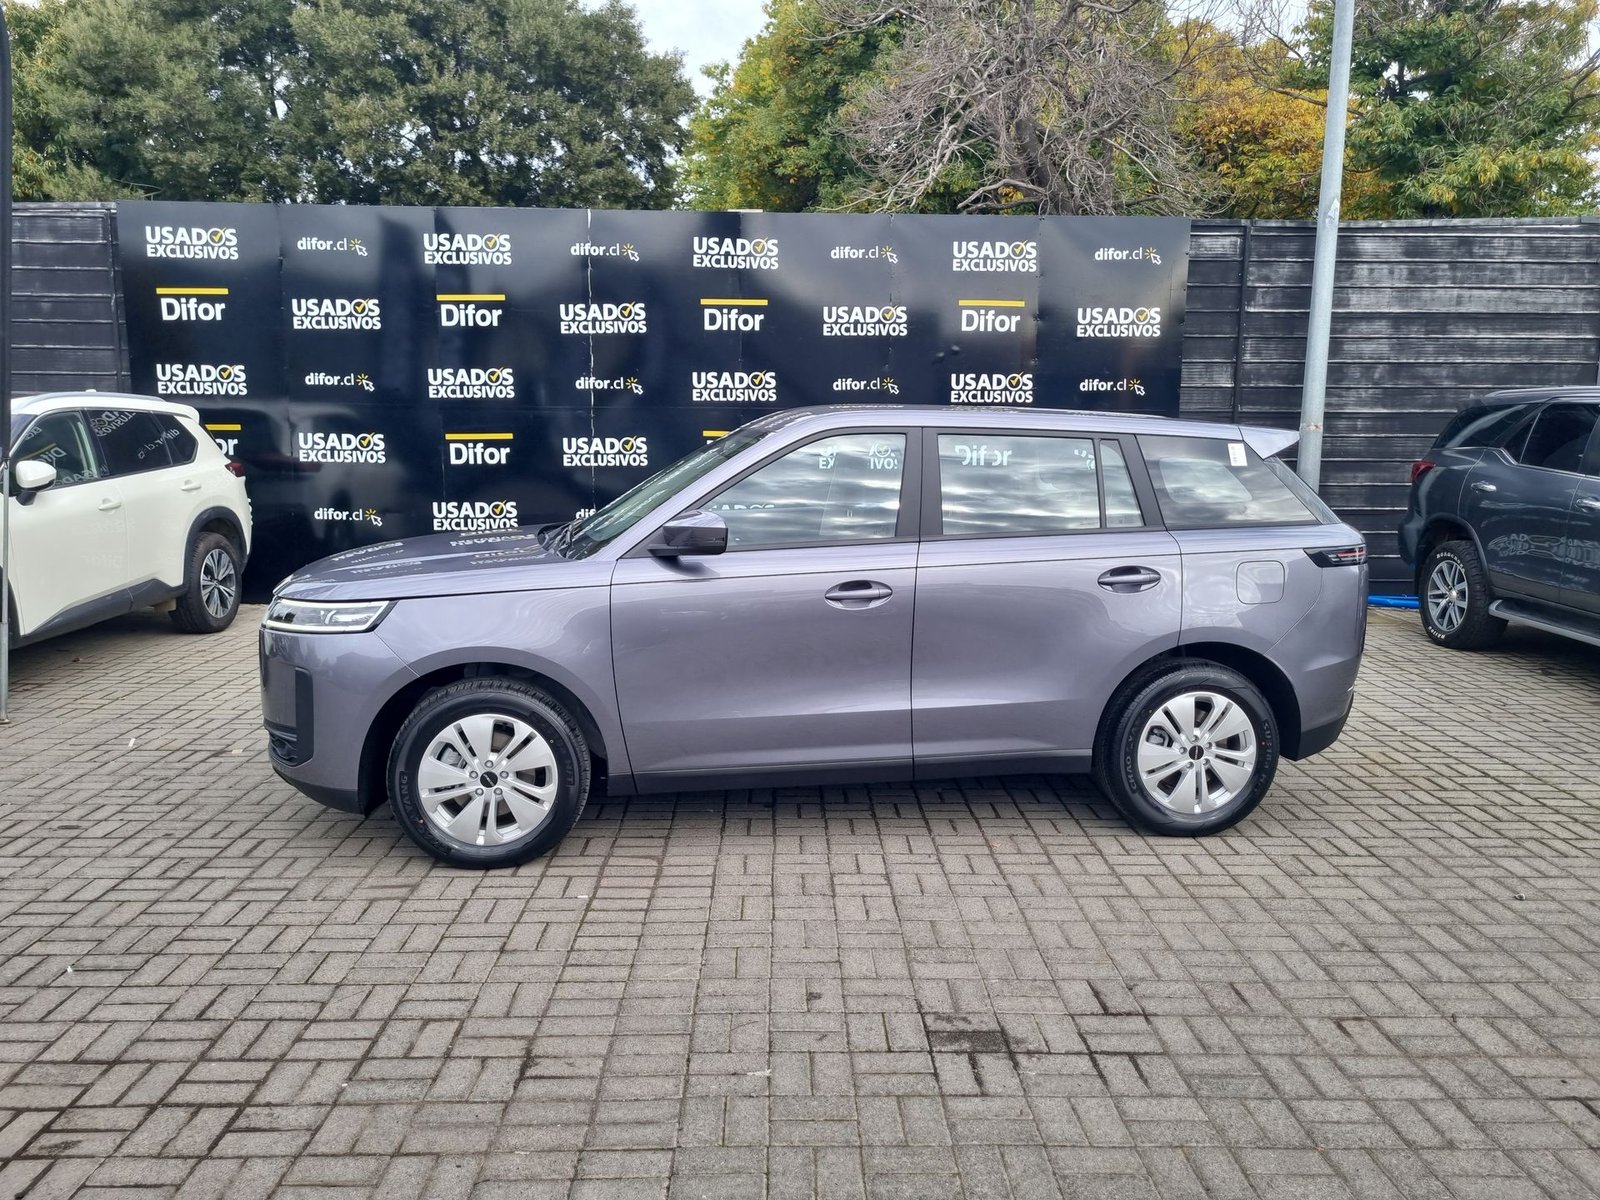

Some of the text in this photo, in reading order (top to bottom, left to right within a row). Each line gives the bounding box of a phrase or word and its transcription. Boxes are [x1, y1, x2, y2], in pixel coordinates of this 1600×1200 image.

[145, 226, 238, 246] USADOS
[423, 232, 512, 251] USADOS
[297, 237, 347, 251] difor.cl
[570, 243, 620, 257] difor.cl
[693, 236, 779, 257] USADOS
[952, 240, 1037, 259] USADOS
[146, 244, 239, 260] EXCLUSIVOS
[424, 251, 512, 266] EXCLUSIVOS
[830, 246, 879, 259] difor.cl
[1094, 247, 1143, 261] difor.cl
[693, 254, 779, 270] EXCLUSIVOS
[952, 258, 1037, 272] EXCLUSIVOS
[160, 297, 226, 321] Difor
[292, 298, 381, 317] USADOS
[440, 303, 503, 327] Difor
[559, 302, 646, 321] USADOS
[822, 305, 907, 324] USADOS
[293, 316, 382, 330] EXCLUSIVOS
[703, 308, 765, 332] Difor
[960, 309, 1021, 333] Difor
[1077, 306, 1161, 325] USADOS
[560, 320, 647, 335] EXCLUSIVOS
[823, 323, 908, 337] EXCLUSIVOS
[1076, 324, 1161, 338] EXCLUSIVOS
[156, 364, 246, 382] USADOS
[305, 372, 355, 386] difor.cl
[427, 367, 514, 386] USADOS
[692, 370, 776, 389] USADOS
[157, 381, 247, 396] EXCLUSIVOS
[575, 376, 624, 390] difor.cl
[832, 377, 881, 391] difor.cl
[951, 372, 1033, 391] USADOS
[1079, 378, 1127, 392] difor.cl
[428, 385, 515, 399] EXCLUSIVOS
[692, 388, 777, 402] EXCLUSIVOS
[950, 390, 1033, 404] EXCLUSIVOS
[299, 432, 385, 450] USADOS
[562, 436, 647, 454] USADOS
[299, 449, 386, 464] EXCLUSIVOS
[450, 443, 511, 465] Difor
[563, 453, 648, 467] EXCLUSIVOS
[313, 507, 363, 521] difor.cl
[432, 500, 518, 519] USADOS
[433, 518, 519, 531] EXCLUSIVOS
